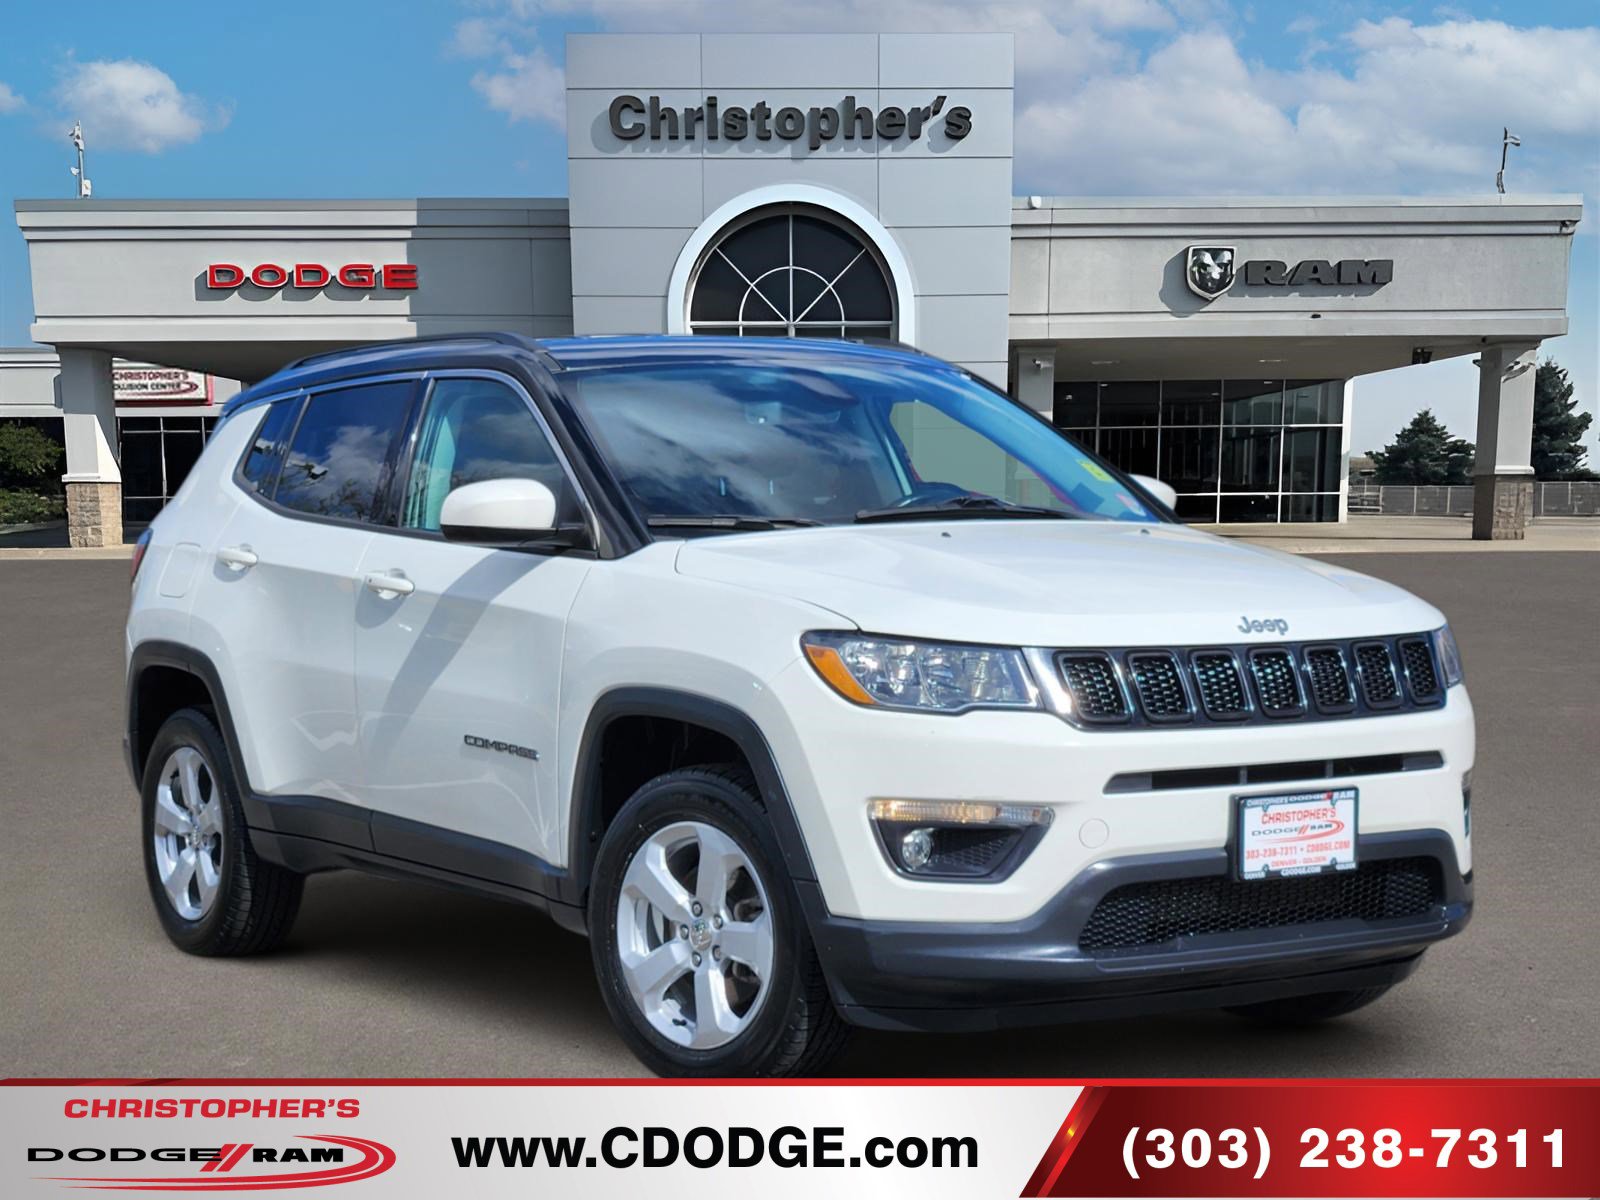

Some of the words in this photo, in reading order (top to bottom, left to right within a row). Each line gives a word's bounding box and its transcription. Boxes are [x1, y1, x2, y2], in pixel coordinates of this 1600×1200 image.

[608, 94, 973, 151] Christopher's
[206, 263, 418, 289] DODGE
[1244, 259, 1393, 285] RAM
[113, 382, 148, 391] OLLISION
[150, 382, 181, 391] CENTER
[1237, 615, 1289, 636] Jeep
[464, 734, 539, 761] COMPASS
[1261, 808, 1337, 825] CHRISTOPHER'S
[1251, 827, 1300, 837] DODGE
